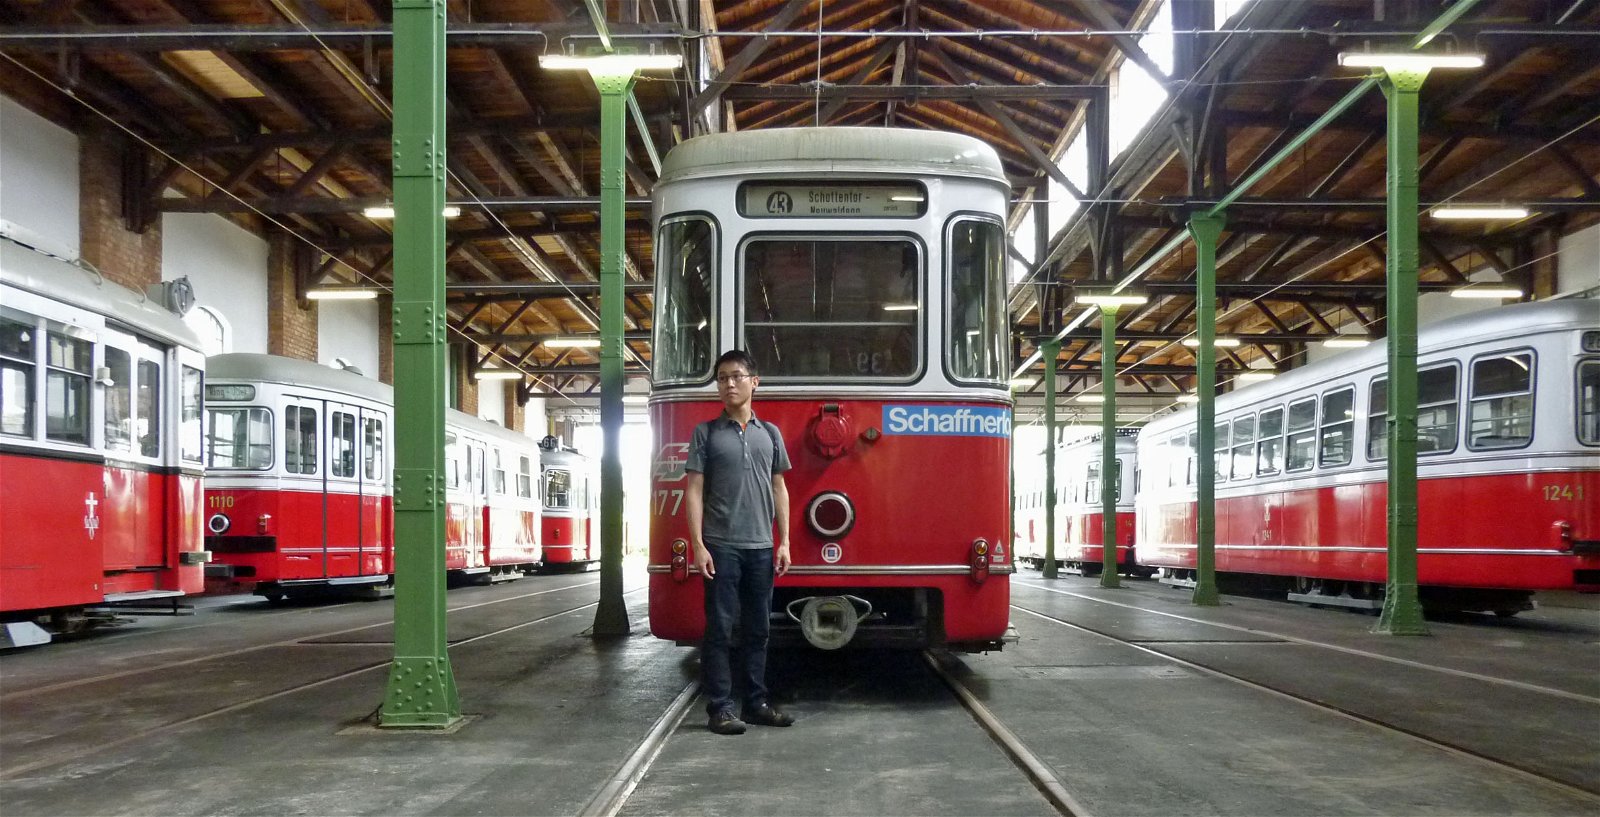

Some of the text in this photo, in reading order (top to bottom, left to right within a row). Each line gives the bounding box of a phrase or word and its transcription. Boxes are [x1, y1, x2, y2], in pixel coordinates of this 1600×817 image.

[769, 192, 789, 213] 43
[808, 191, 861, 203] Schottentor
[543, 437, 556, 448] 66
[1542, 484, 1584, 501] 1241
[209, 495, 234, 508] 1110
